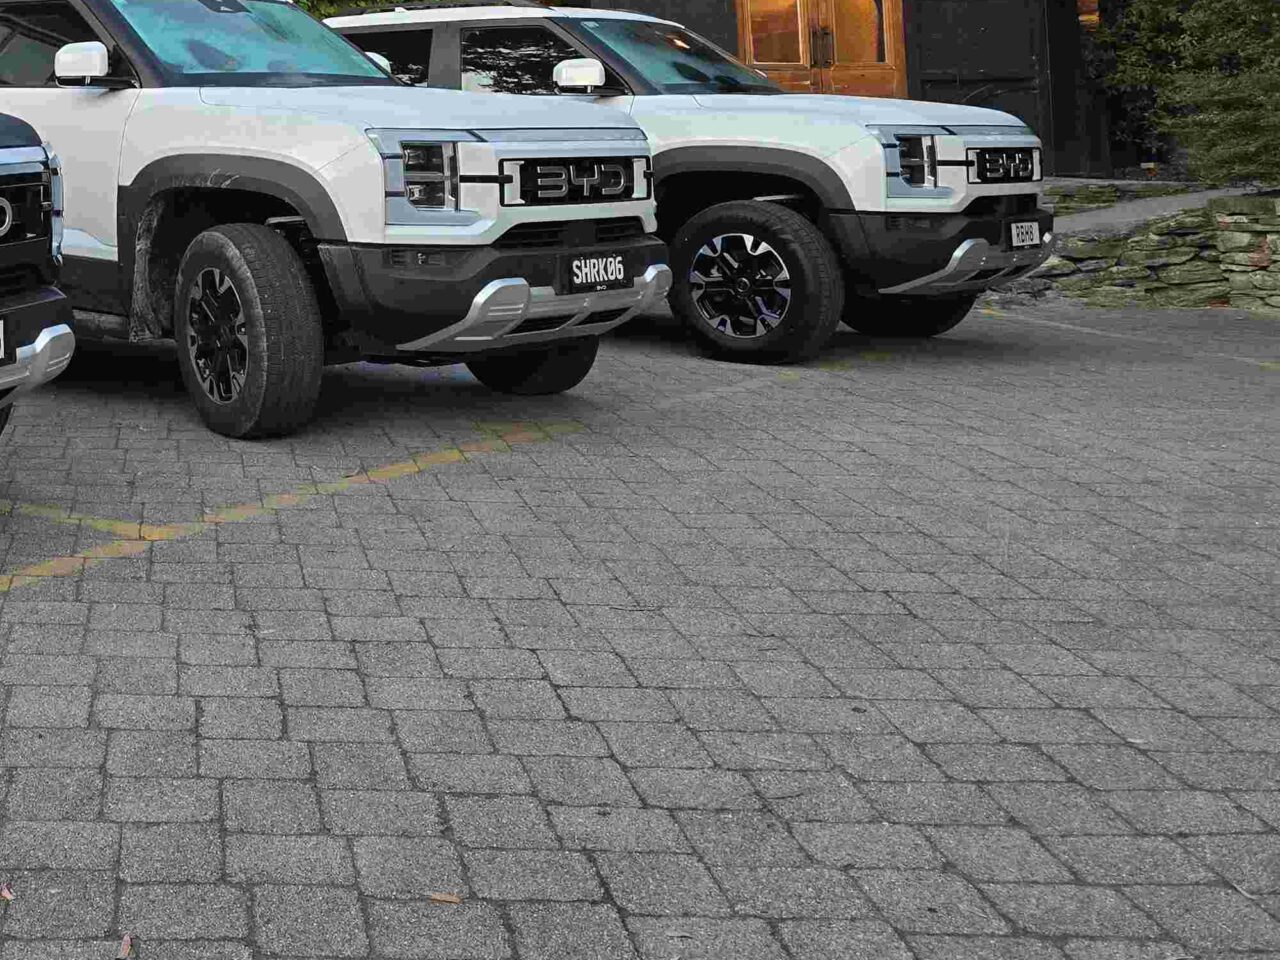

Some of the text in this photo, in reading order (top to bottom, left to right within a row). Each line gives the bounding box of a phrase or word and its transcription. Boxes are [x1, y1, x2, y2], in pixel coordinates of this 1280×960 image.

[985, 153, 1032, 178] BYD
[536, 164, 626, 198] BYD
[572, 256, 624, 284] SHRK06
